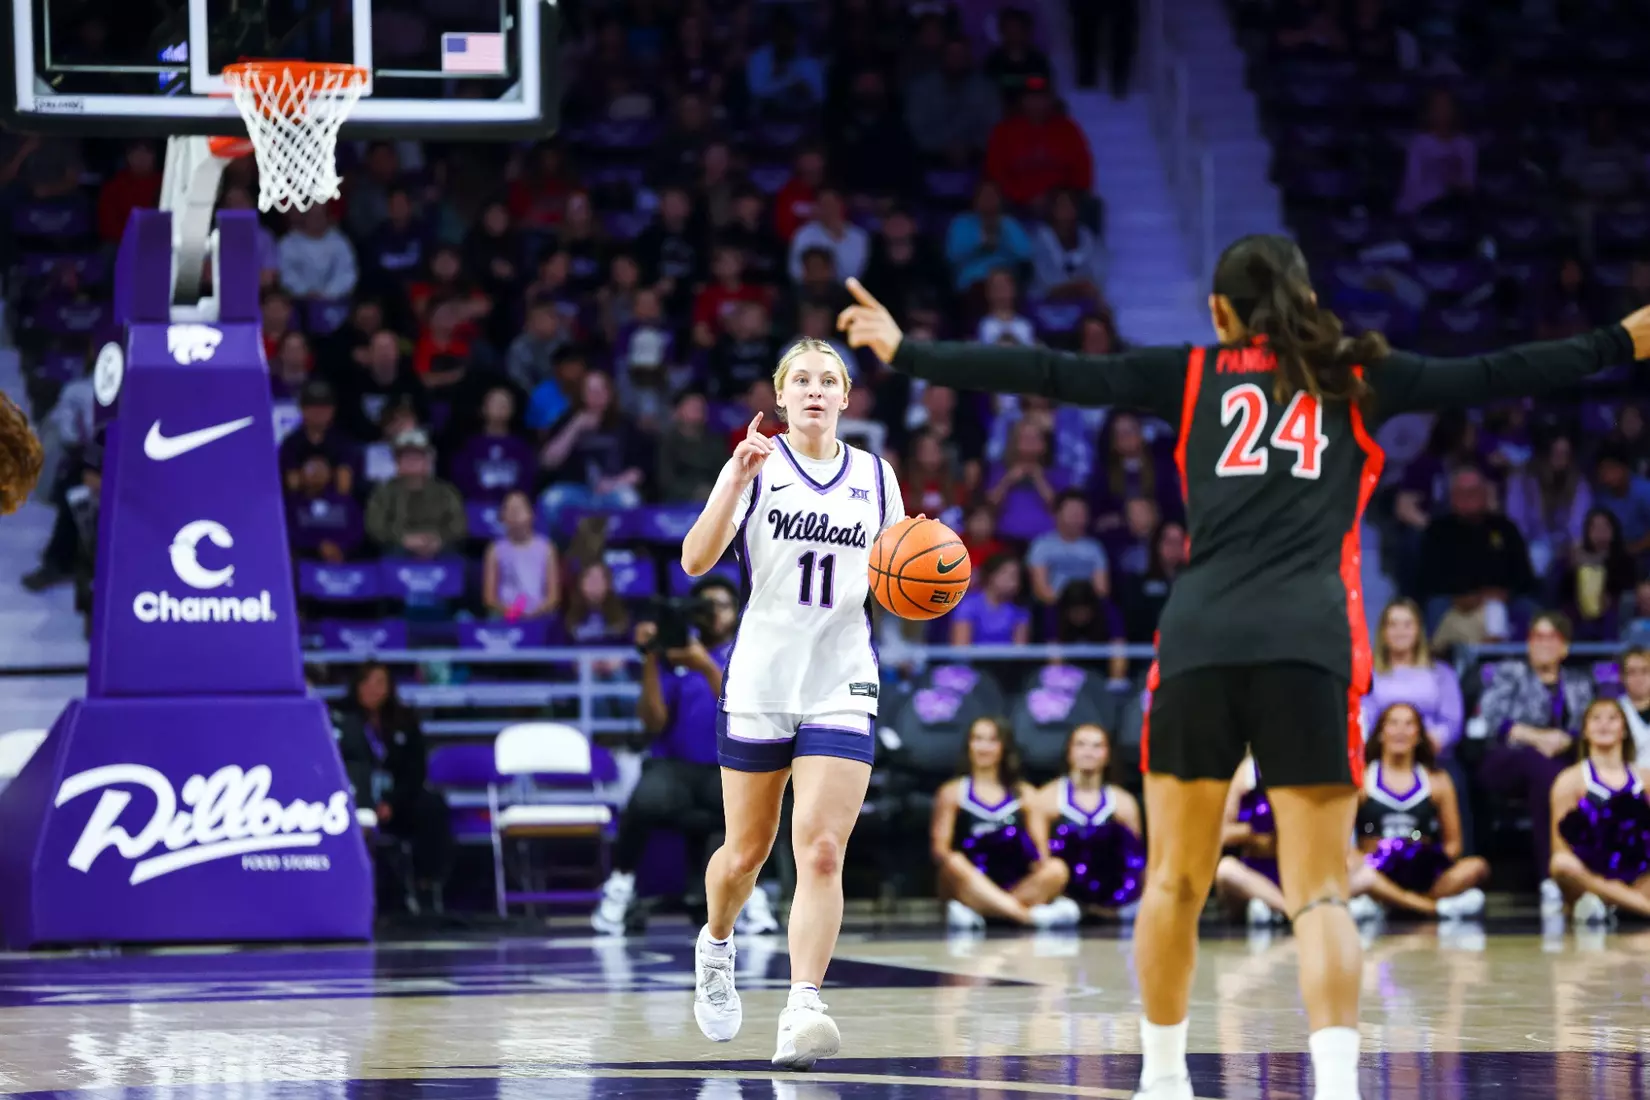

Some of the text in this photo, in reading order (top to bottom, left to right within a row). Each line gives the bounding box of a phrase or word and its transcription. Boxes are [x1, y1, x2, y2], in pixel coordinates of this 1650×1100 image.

[1215, 383, 1329, 479] 24
[768, 509, 866, 548] Wildcats
[133, 589, 276, 623] Channel
[797, 550, 836, 608] 11
[54, 763, 350, 876] Dillons
